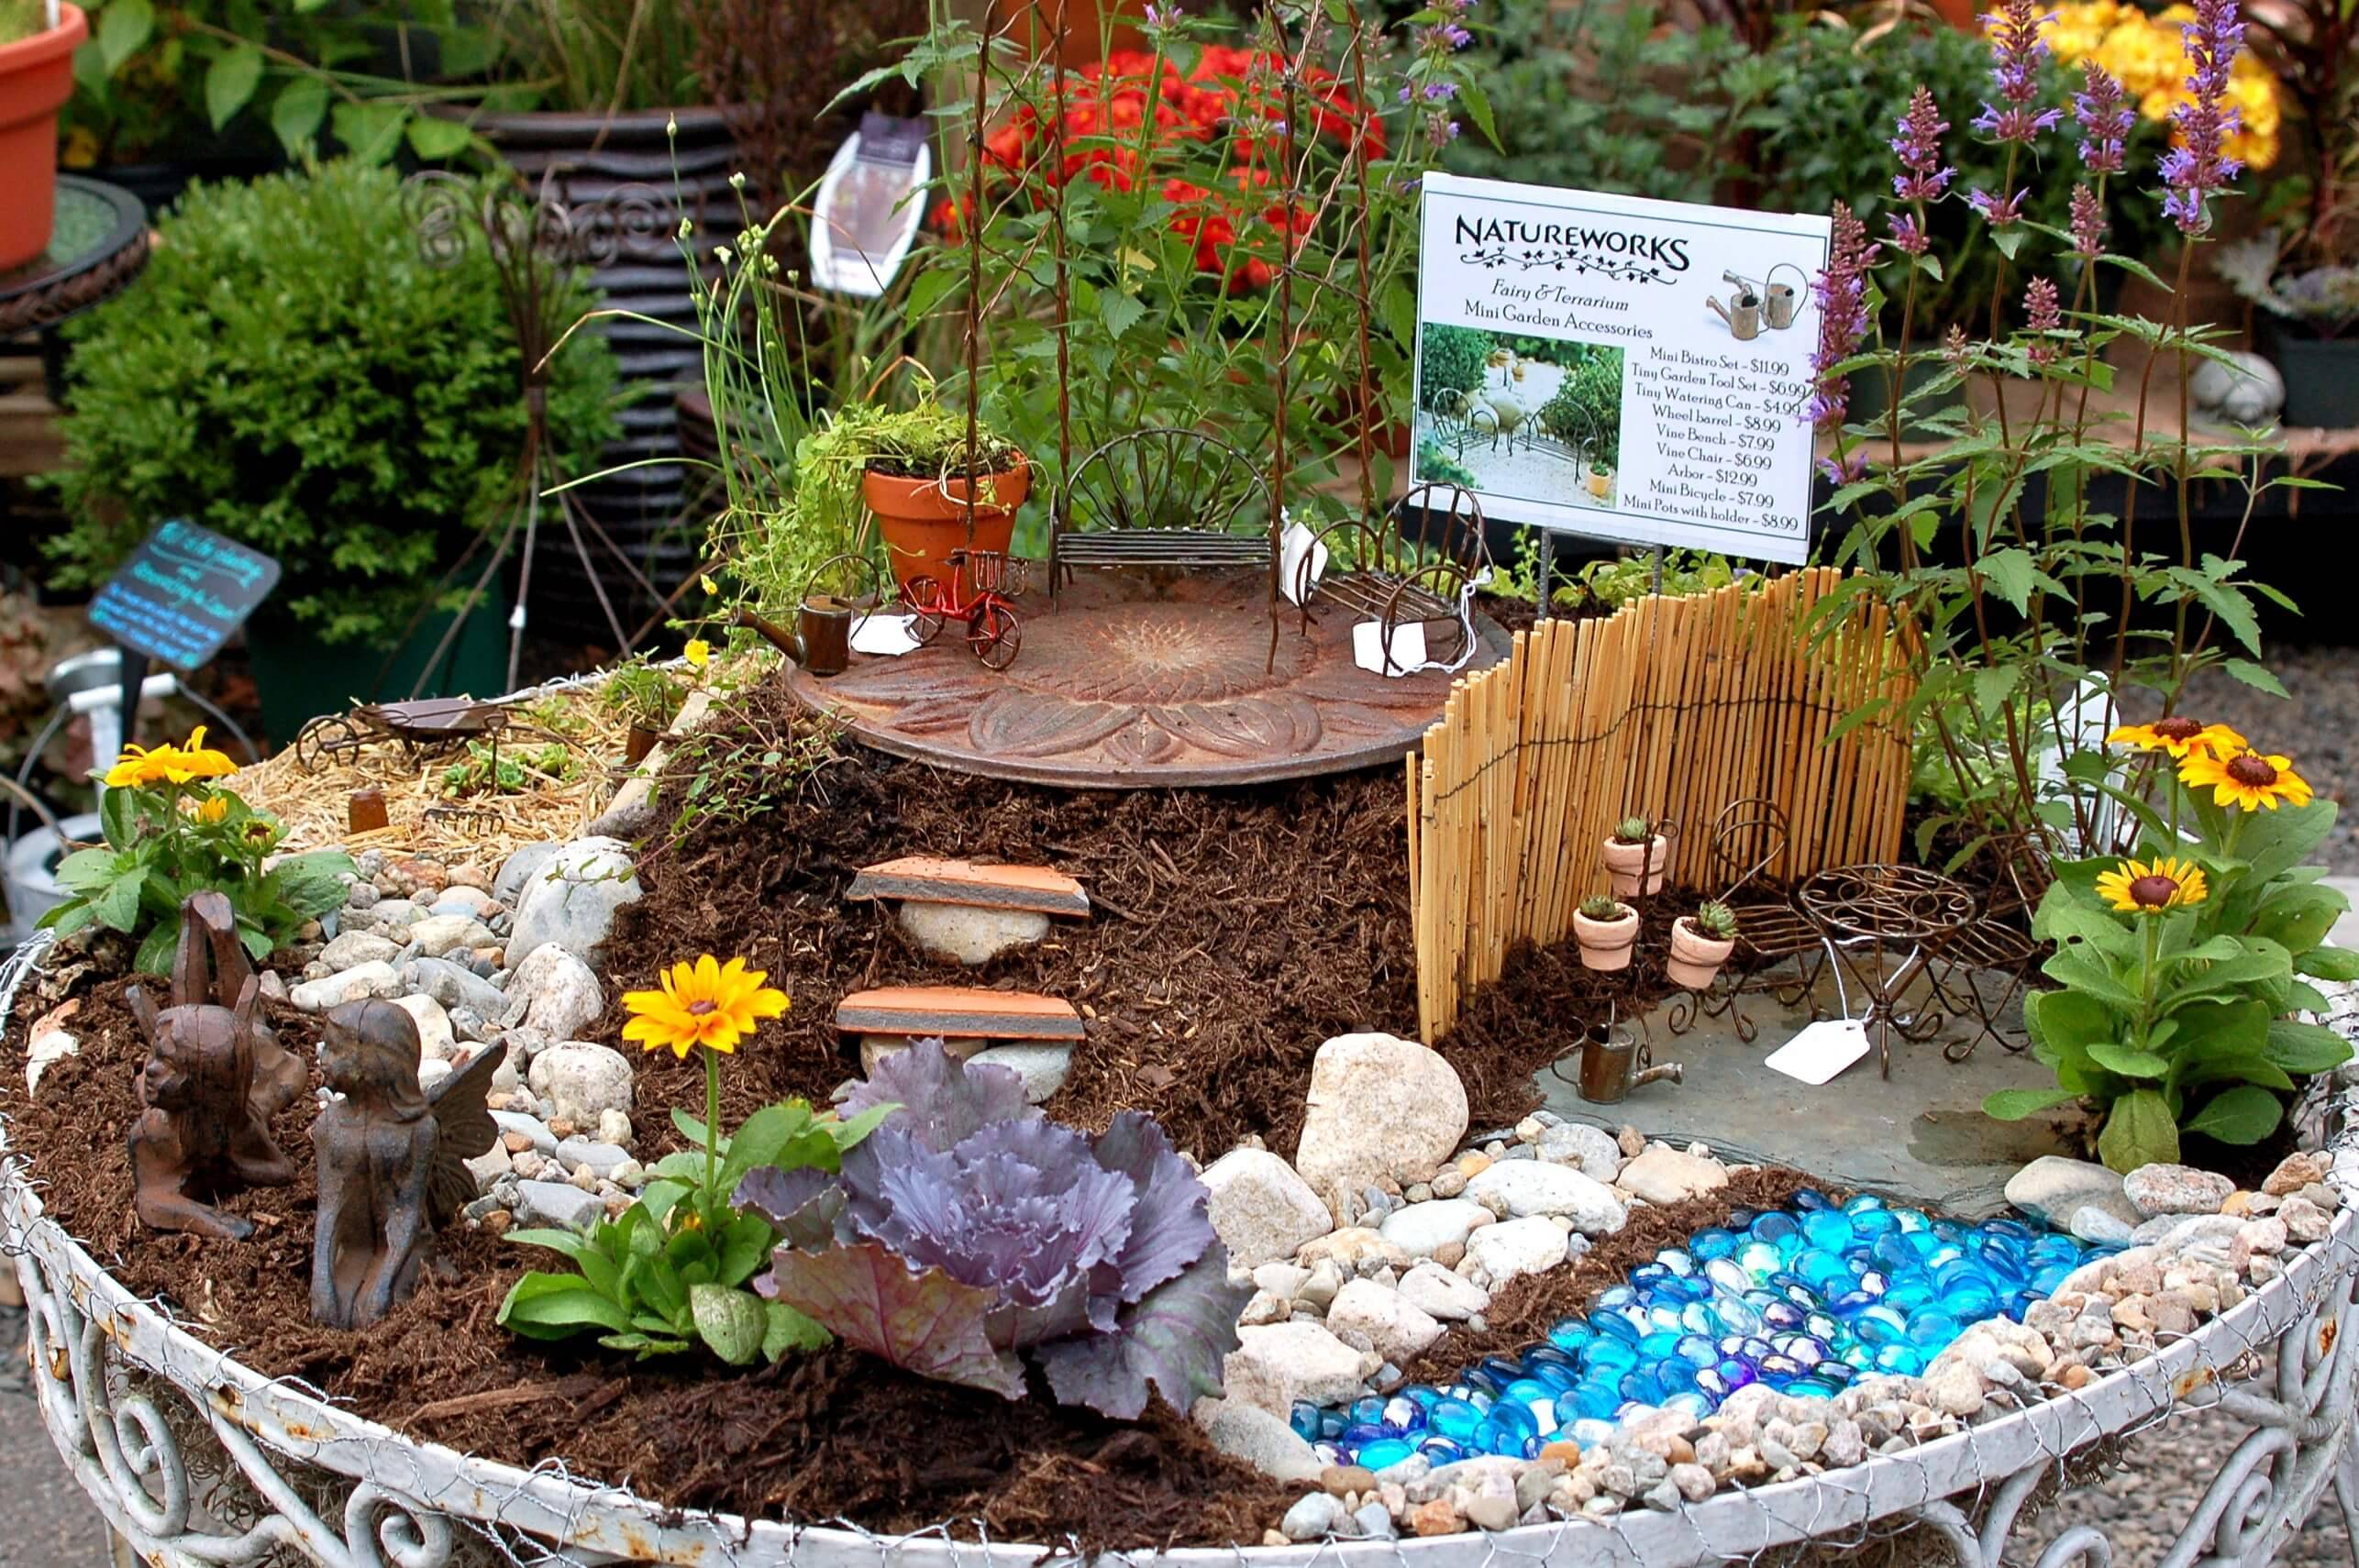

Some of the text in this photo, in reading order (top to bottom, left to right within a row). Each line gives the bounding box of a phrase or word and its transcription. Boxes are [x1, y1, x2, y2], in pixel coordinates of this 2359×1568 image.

[1455, 214, 1689, 271] NATUREWORKS
[1491, 279, 1629, 312] Fairy & Terrarium
[1464, 299, 1653, 339] Mini Garden Accessories
[1651, 346, 1678, 363] Mini
[1680, 349, 1717, 367] Bistro
[1719, 356, 1739, 370] Set
[1750, 358, 1789, 376] $11.99
[1631, 361, 1658, 381] Tiny
[1660, 367, 1706, 386] Garden
[1710, 372, 1735, 389] Tool
[1737, 376, 1757, 392] Set
[1768, 380, 1807, 398] $6.99
[1634, 381, 1661, 400] Tiny
[1664, 385, 1724, 409] Watering
[1725, 394, 1752, 411] Can
[1763, 399, 1801, 416] $4.99
[1653, 403, 1693, 422] Wheel
[1696, 409, 1733, 427] barrel
[1744, 414, 1781, 434] $8.99
[1656, 423, 1685, 440] Vine
[1688, 427, 1726, 446] Bench
[1737, 434, 1776, 452] $7.99
[1656, 442, 1686, 458] Vine
[1688, 447, 1723, 464] Chair
[1733, 452, 1772, 470] $6.99
[1667, 463, 1704, 480] Arbor
[1715, 469, 1757, 488] $12.99
[1649, 479, 1678, 495] Mini
[1680, 482, 1726, 502] Bicycle
[1737, 491, 1774, 509] $7.99
[1623, 493, 1651, 510] Mini
[1655, 498, 1678, 515] Pots
[1681, 504, 1708, 519] with
[1710, 508, 1750, 525] holder
[1761, 513, 1799, 532] $8.99
